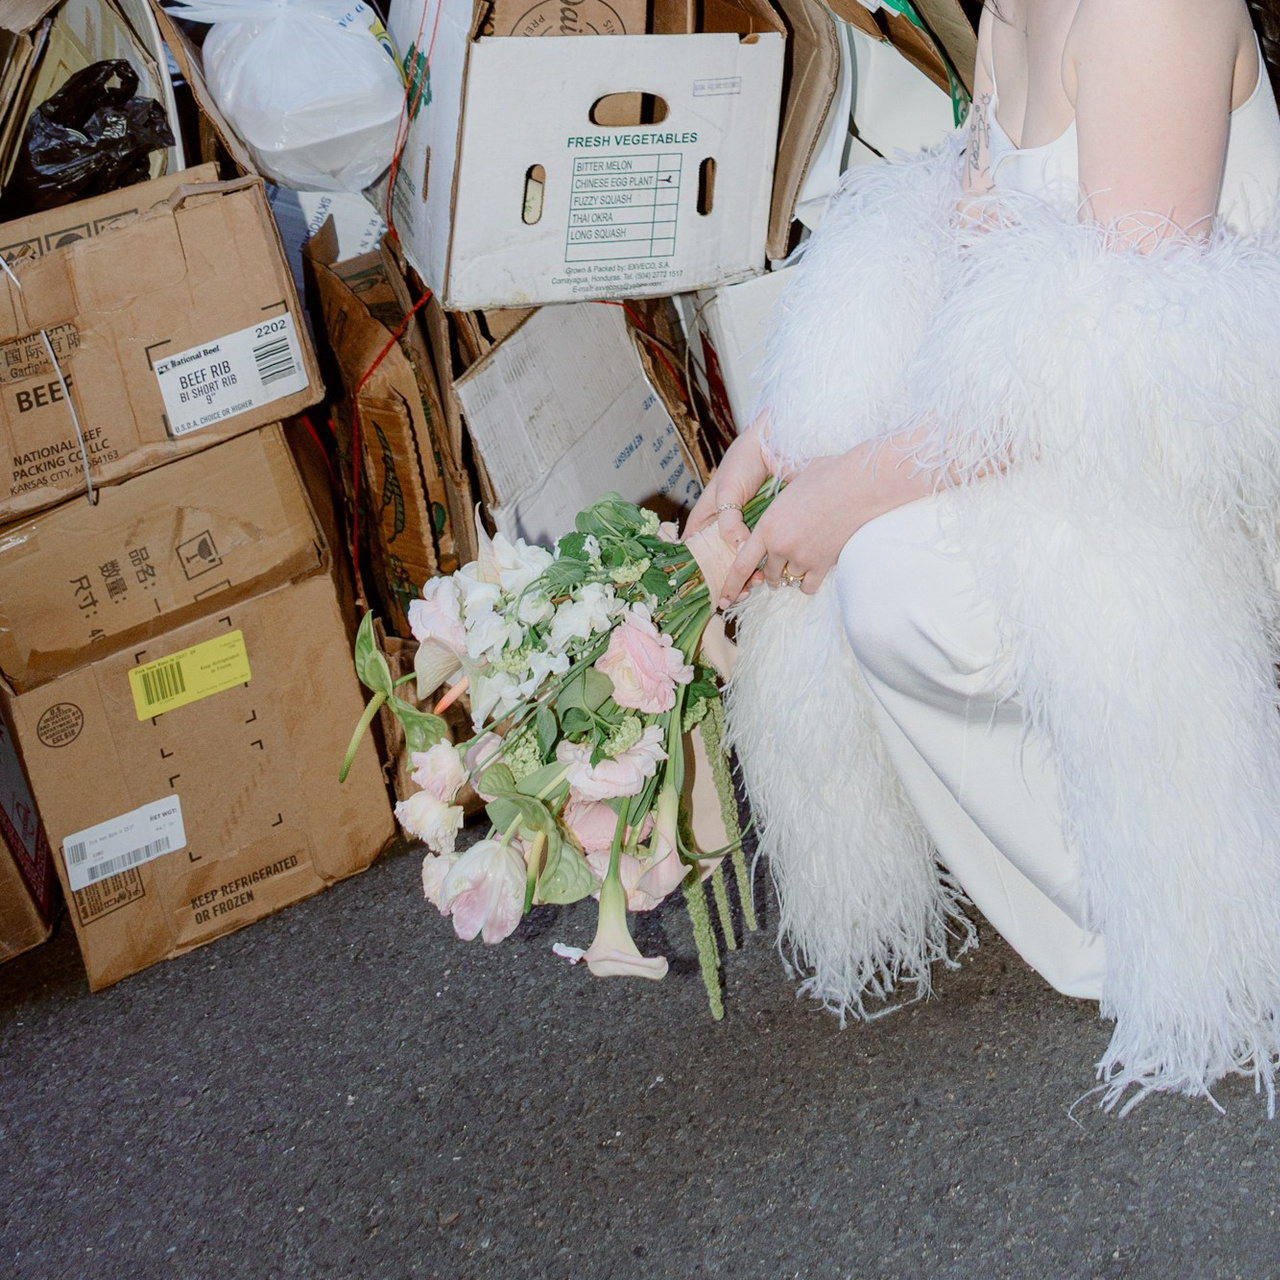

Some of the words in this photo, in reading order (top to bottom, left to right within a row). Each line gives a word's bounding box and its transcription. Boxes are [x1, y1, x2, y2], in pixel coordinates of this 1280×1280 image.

[567, 135, 612, 149] FRESH
[614, 131, 699, 147] VEGETABLES
[576, 161, 604, 173] BITTER
[605, 160, 633, 171] MELON
[575, 177, 609, 190] CHINESE
[609, 176, 628, 188] EGG
[629, 175, 654, 186] PLANT
[573, 195, 599, 207] FUZZY
[600, 193, 632, 205] SQUASH
[572, 213, 590, 224] THAI
[591, 212, 613, 223] OKRA
[570, 229, 593, 241] LONG
[594, 227, 627, 239] SQUASH
[565, 266, 587, 276] Grown
[593, 264, 616, 274] Packed
[635, 271, 651, 281] (504)
[652, 270, 668, 279] 2772
[669, 269, 683, 278] 1517
[255, 319, 287, 338] 2202
[170, 351, 202, 368] National
[202, 344, 220, 357] Beef
[179, 367, 208, 390] BEEF
[210, 360, 232, 379] RIB
[179, 391, 191, 403] BI
[193, 381, 220, 398] SHORT
[222, 373, 238, 388] RIB
[16, 374, 74, 414] BEEF
[175, 419, 199, 434] U.S.D.A.
[200, 410, 221, 424] CHOICE
[222, 407, 231, 416] OR
[231, 399, 254, 413] HIGHER
[12, 456, 66, 482] PACKING
[89, 438, 110, 454] LLC
[13, 439, 76, 467] NATIONAL
[9, 476, 49, 497] KANSAS
[50, 469, 74, 484] CITY,
[69, 574, 99, 619] 尺寸：
[191, 888, 218, 911] KEEP
[220, 854, 299, 898] REFRIGERATED
[195, 908, 211, 926] OR
[213, 890, 255, 918] FROZEN
